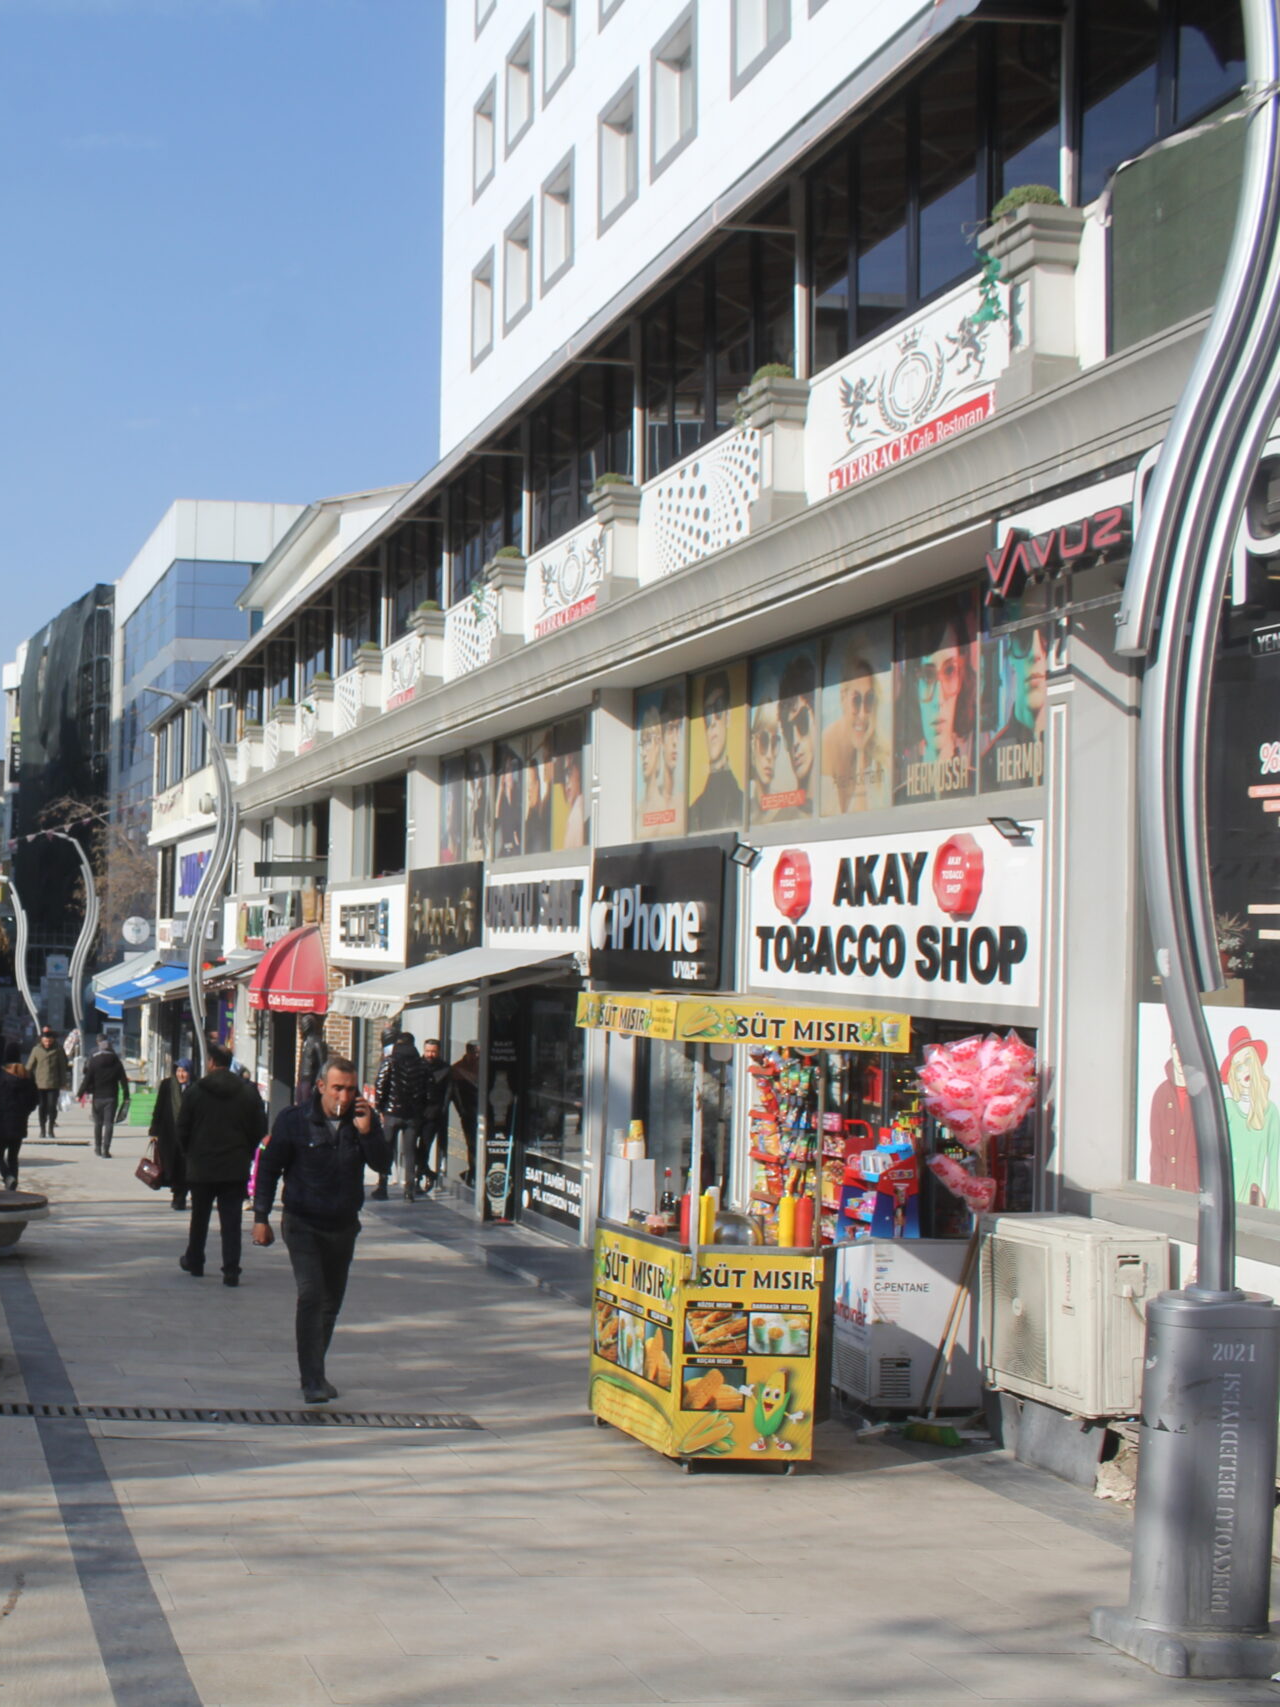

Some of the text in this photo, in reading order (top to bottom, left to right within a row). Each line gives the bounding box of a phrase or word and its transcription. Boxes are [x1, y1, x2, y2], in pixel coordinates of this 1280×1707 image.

[839, 406, 984, 488] TERRACE Cafe Restoran
[984, 506, 1123, 606] YAVUZ
[906, 755, 968, 797] HERMOSSA
[832, 851, 929, 907] AKAY
[611, 884, 700, 953] iPhone
[672, 960, 699, 980] UYAR
[755, 924, 1028, 985] TOBACCO SHOP
[736, 1011, 861, 1044] SÜT MISIR
[525, 1167, 543, 1183] SAAT
[604, 1241, 666, 1300] SÜT MISIR
[700, 1264, 816, 1290] SÜT MISIR
[873, 1282, 930, 1293] C-PENTANE
[1211, 1342, 1257, 1363] 2021
